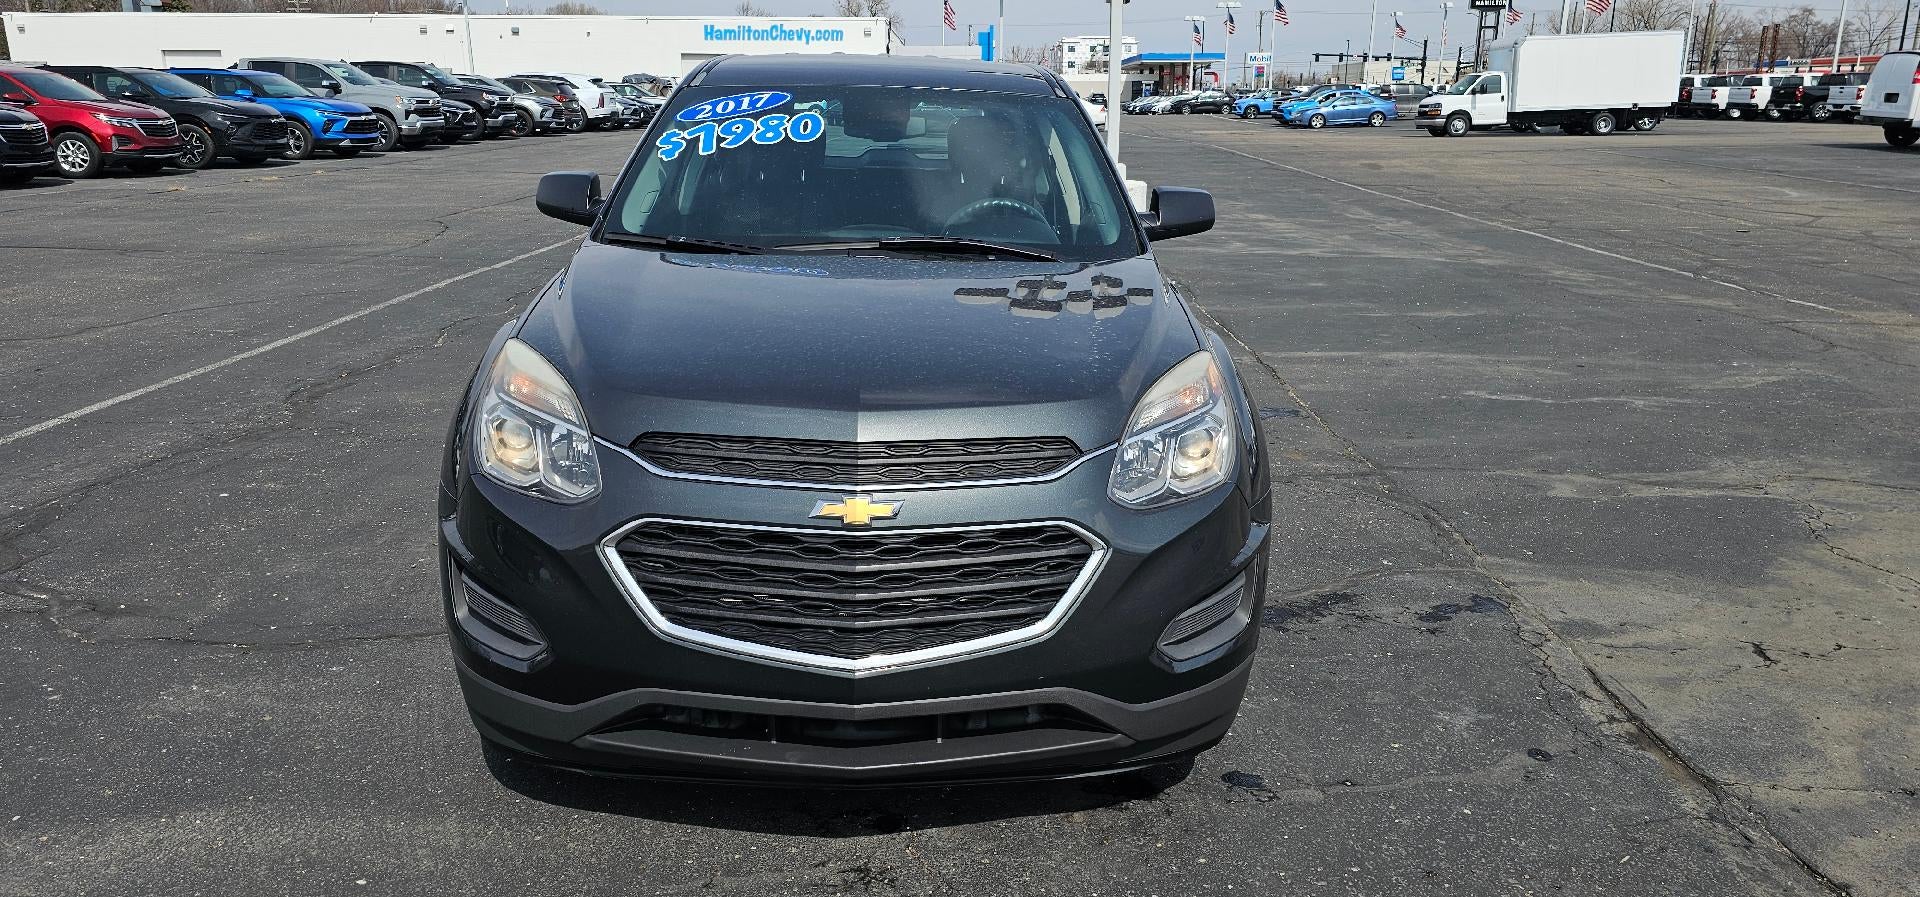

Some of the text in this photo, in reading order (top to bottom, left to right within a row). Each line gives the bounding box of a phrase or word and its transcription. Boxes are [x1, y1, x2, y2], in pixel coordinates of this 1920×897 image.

[703, 24, 844, 45] HamiltonChevy.com
[696, 93, 773, 120] 2017
[656, 111, 825, 161] $7980
